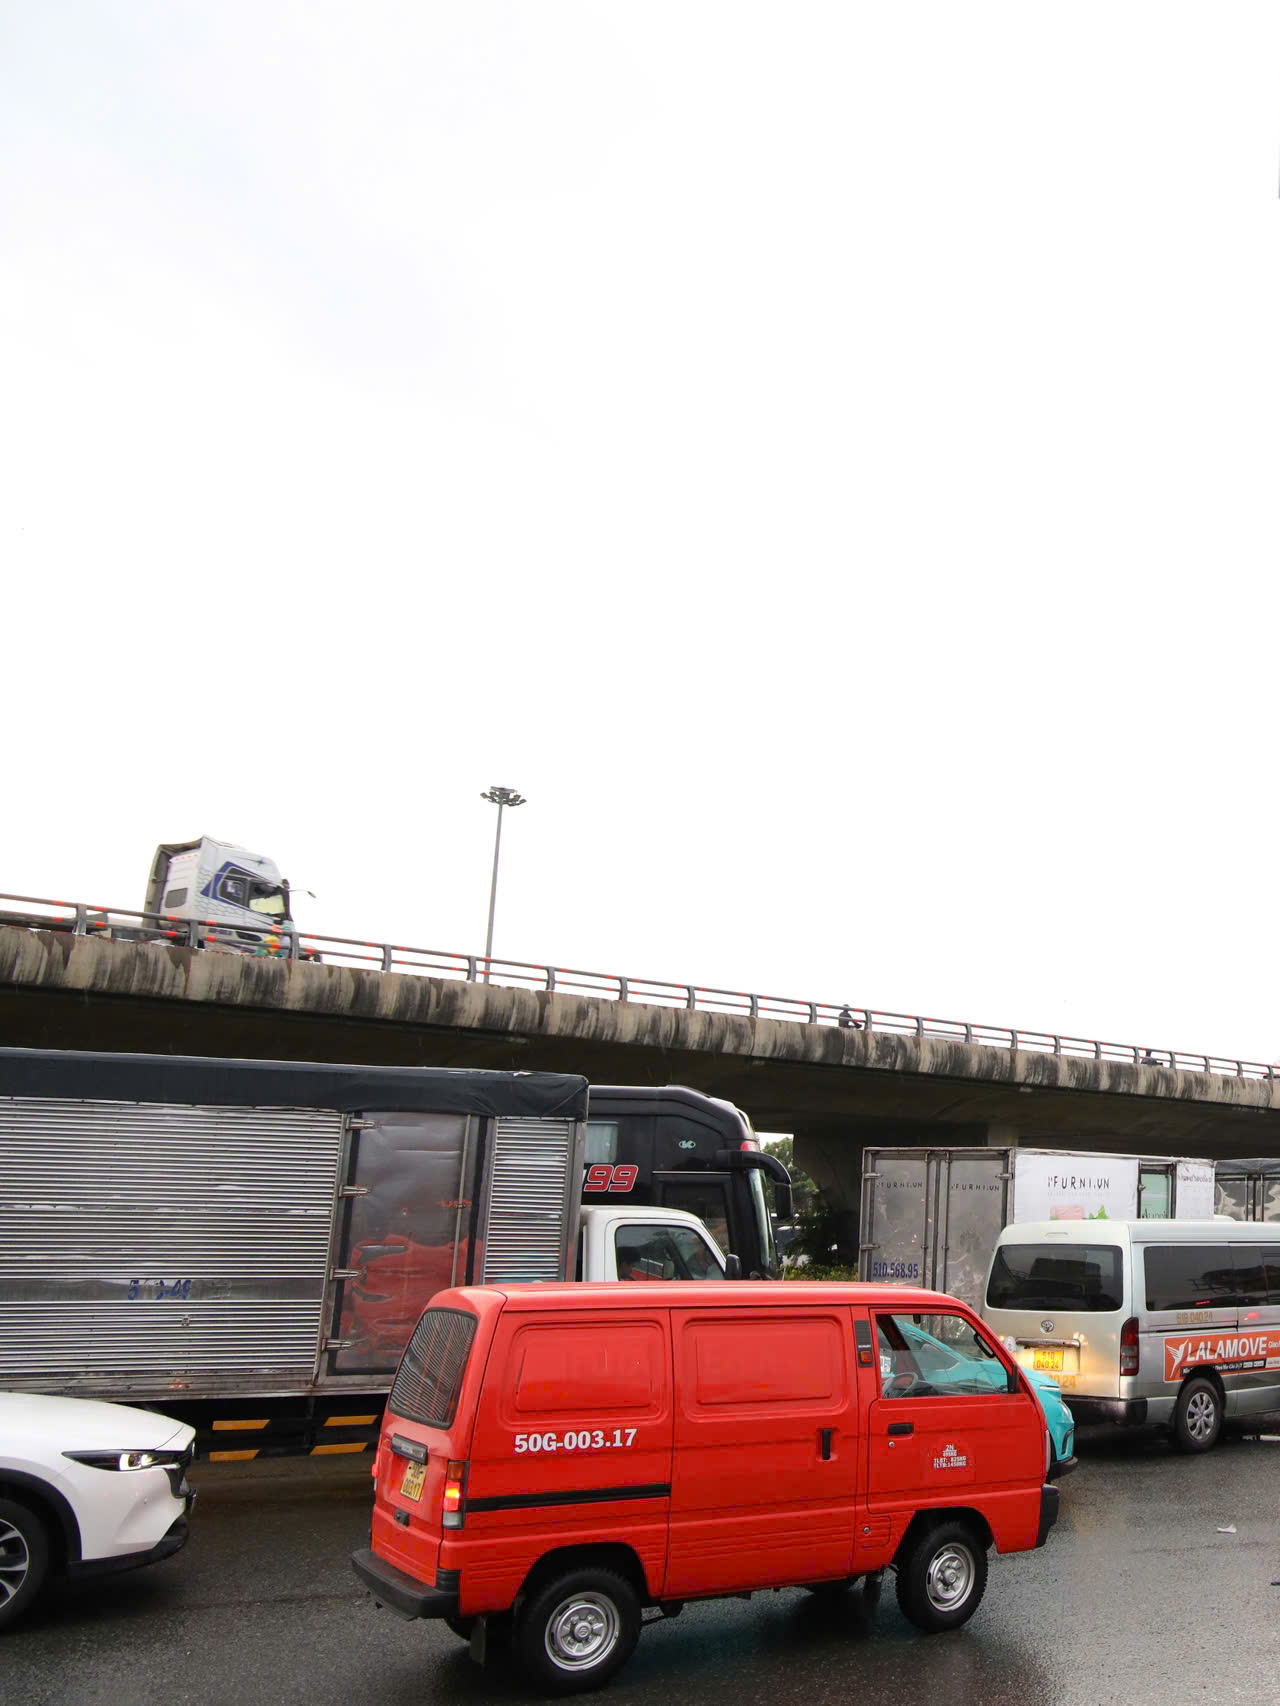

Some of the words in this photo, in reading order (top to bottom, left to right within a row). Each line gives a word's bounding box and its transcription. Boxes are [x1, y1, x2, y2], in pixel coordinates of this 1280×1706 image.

[584, 1164, 639, 1193] 99
[1186, 1336, 1268, 1361] LALAMOVE
[513, 1428, 637, 1453] 50G-003.17
